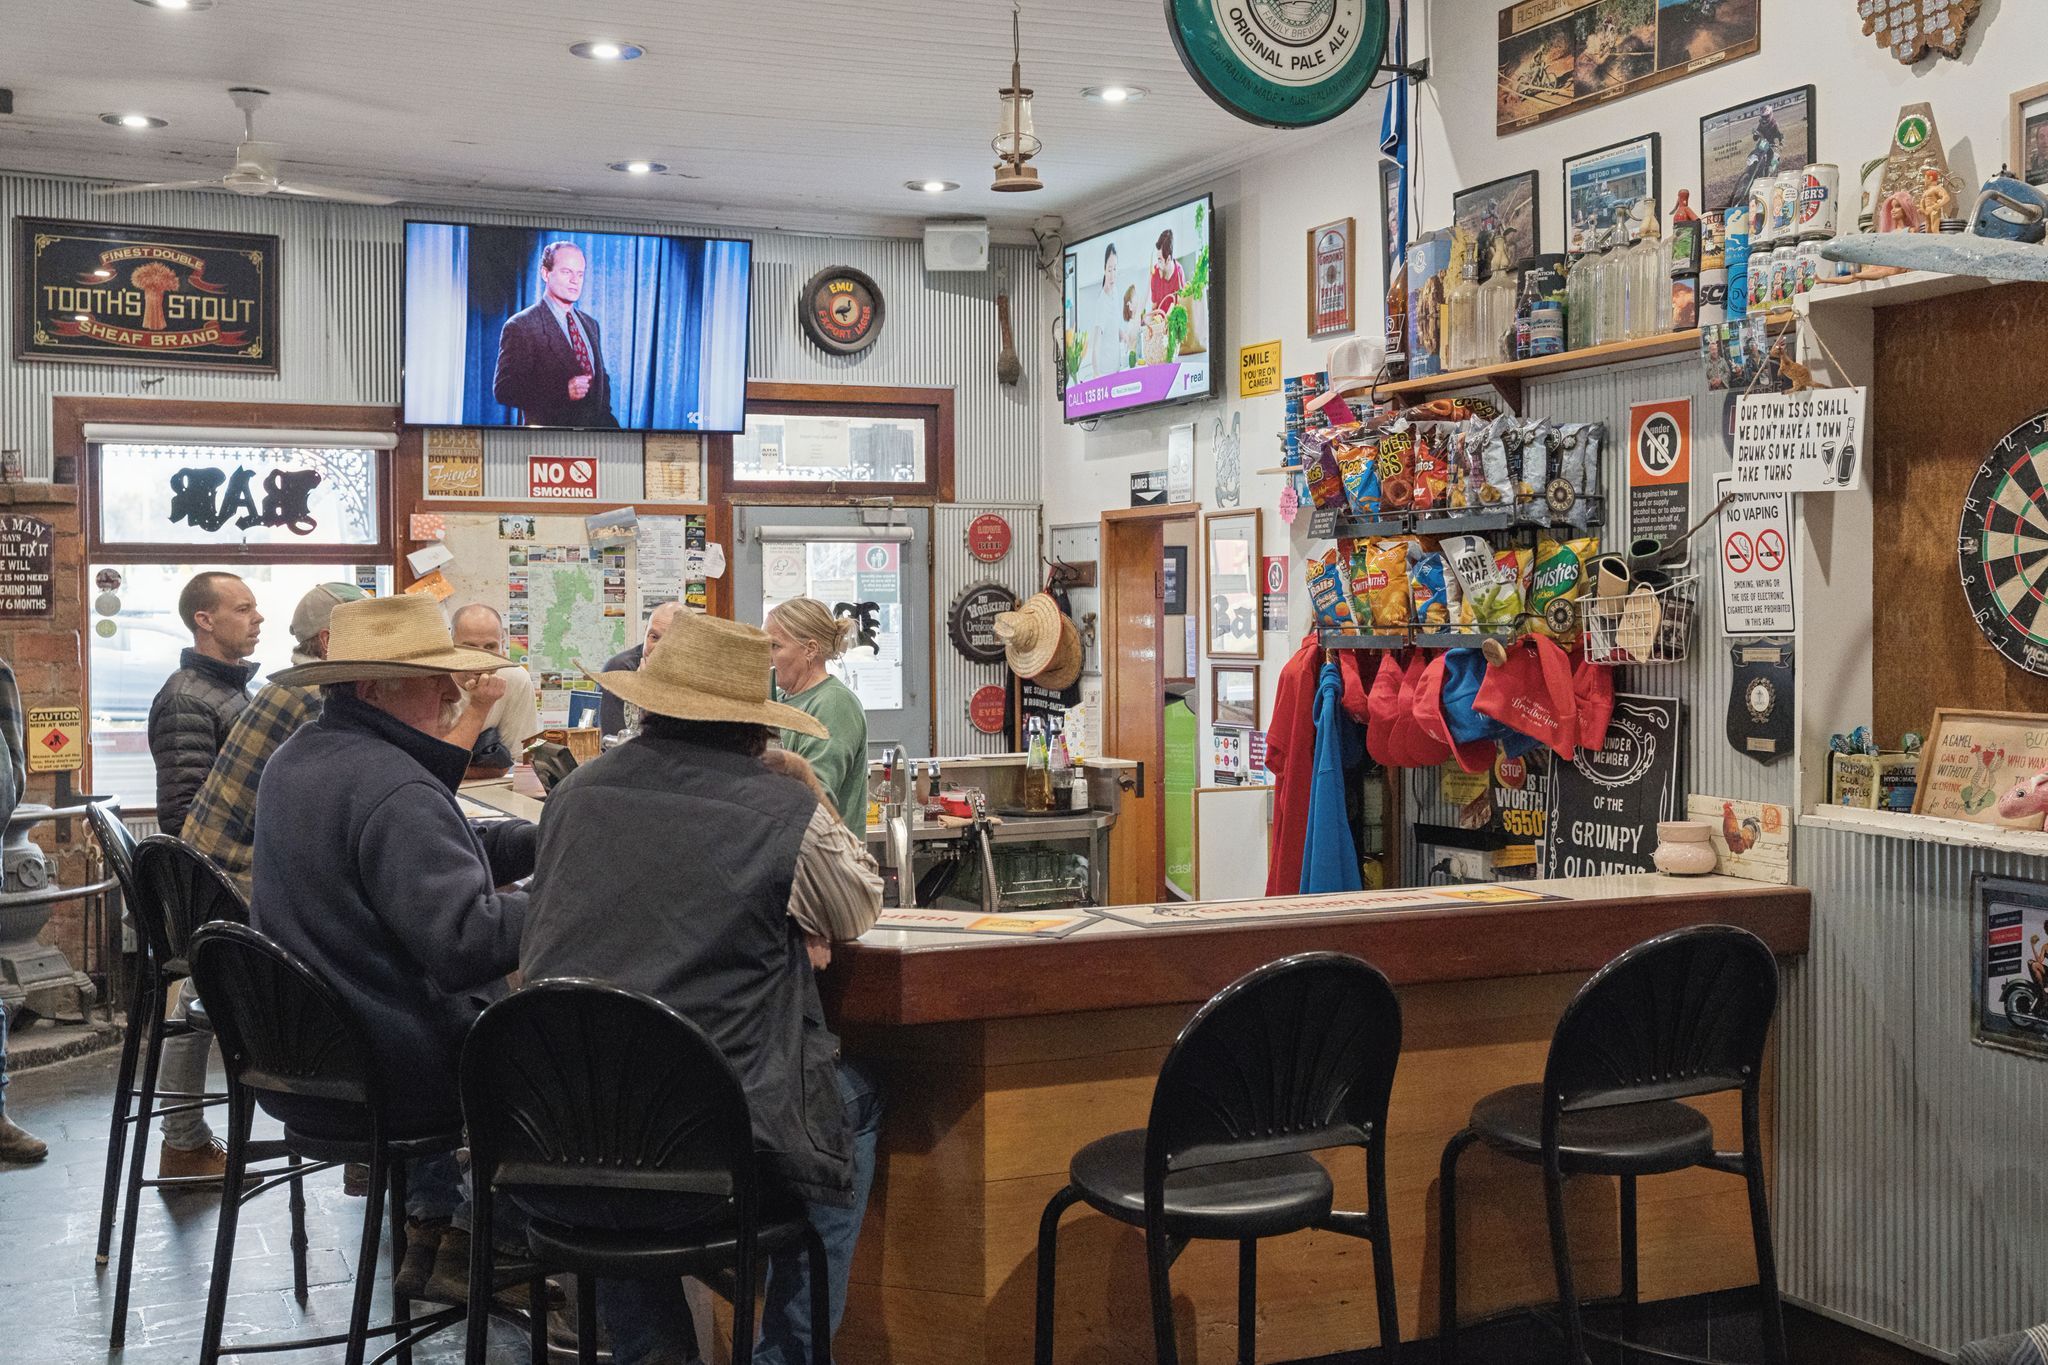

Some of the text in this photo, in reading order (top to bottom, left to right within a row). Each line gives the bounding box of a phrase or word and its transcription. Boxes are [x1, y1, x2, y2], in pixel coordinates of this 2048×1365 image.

[1262, 11, 1324, 38] FAMILY BREWED
[1229, 7, 1349, 70] ORIGINAL PALE ALE
[101, 248, 205, 269] FINEST DOUBLE
[829, 282, 853, 293] EMU
[43, 286, 255, 323] TOOTH'S STOUT
[818, 306, 871, 338] EXPORT LAGER
[78, 320, 219, 346] SHEAF BRAND
[1243, 351, 1270, 368] SMILE
[1191, 371, 1204, 383] real
[1244, 367, 1276, 380] YOU'RE ON
[1249, 377, 1273, 389] CAMERA
[1068, 393, 1085, 407] CALL
[1085, 389, 1096, 403] 135
[1097, 386, 1109, 401] 814
[1741, 399, 1848, 421] OUR TOWN IS SO SMALL
[1739, 421, 1841, 441] WE DON'T HAVE A TOWN
[2032, 420, 2042, 434] 5
[430, 430, 479, 448] BEER
[1646, 433, 1670, 465] 18
[1739, 442, 1817, 462] DRUNK SO WE ALL
[460, 456, 479, 464] WIN
[430, 465, 478, 487] Friends
[533, 463, 564, 483] NO
[1738, 464, 1793, 482] TAKE TURNS
[1979, 464, 1994, 478] 9
[532, 487, 593, 498] SMOKING
[1549, 482, 1572, 502] RED ROCK
[1738, 491, 1783, 502] SMOKING
[1551, 501, 1569, 509] DELI
[1964, 497, 1980, 512] 14
[1727, 506, 1779, 522] NO VAPING
[12, 518, 45, 538] MAN
[20, 540, 48, 557] FIX IT
[8, 560, 31, 571] WILL
[1533, 562, 1579, 591] Twisties
[1756, 580, 1773, 588] VAPING
[1961, 575, 1975, 586] 8
[0, 585, 42, 596] EMIND HIM
[1731, 592, 1784, 602] THE USE OF ELECTRONIC
[5, 599, 46, 610] 6 MONTHS
[978, 595, 988, 604] NO
[967, 601, 1011, 618] WORKING
[1550, 602, 1573, 627] RED ROCK
[1727, 604, 1790, 614] CIGARETTES ARE PROHIBITED
[1550, 616, 1562, 630] DELI
[1745, 618, 1774, 627] IN THIS AREA
[30, 712, 79, 721] CAUTION
[1942, 735, 1972, 748] A CAMEL
[1593, 753, 1629, 767] MEMBER
[1941, 754, 1969, 764] CAN GO
[2008, 755, 2026, 768] WHO
[1501, 764, 1521, 777] STOP
[1937, 765, 1972, 779] WITHOUT
[1527, 774, 1548, 792] IS IT
[1939, 783, 1961, 793] DRINK
[1495, 788, 1543, 810] WORTH
[1594, 796, 1623, 812] OF THE
[1572, 821, 1644, 854] GRUMPY
[1564, 856, 1596, 878] OLD
